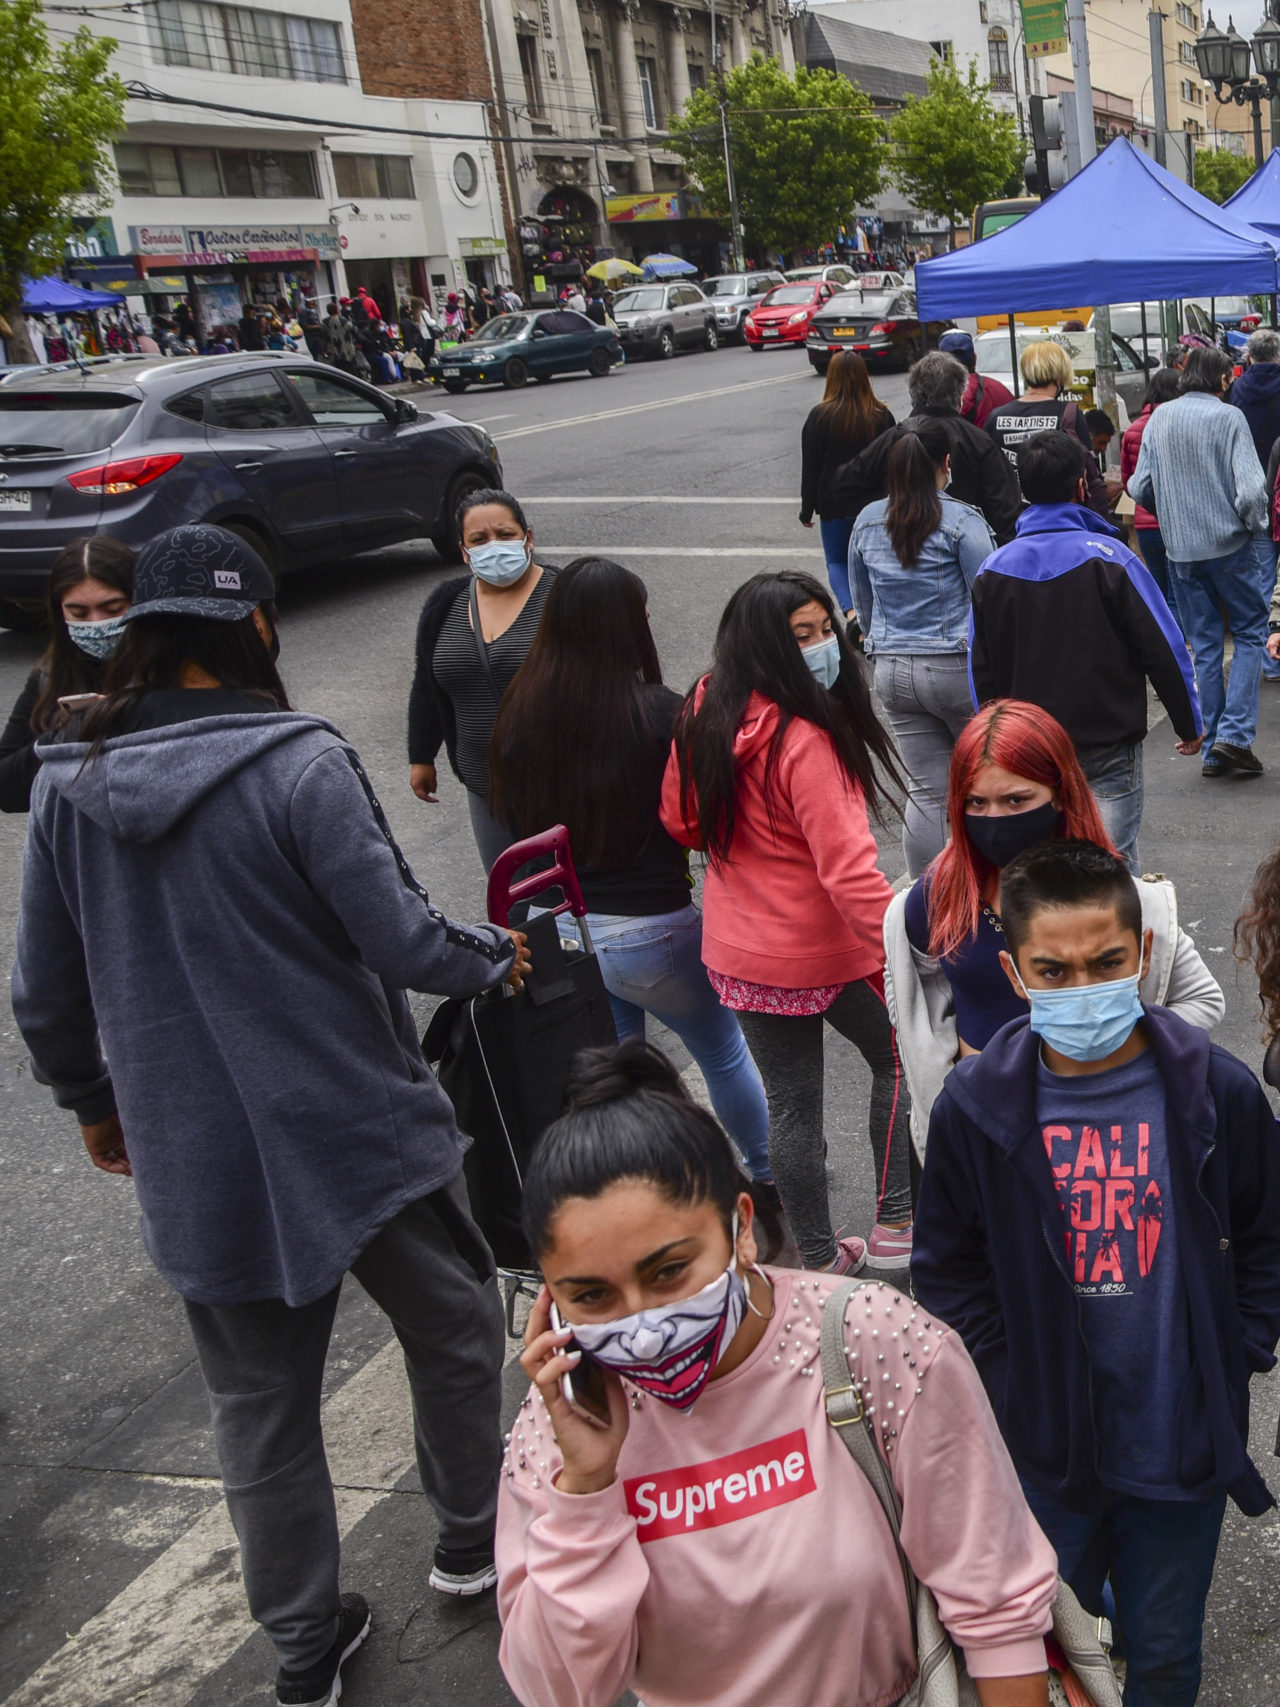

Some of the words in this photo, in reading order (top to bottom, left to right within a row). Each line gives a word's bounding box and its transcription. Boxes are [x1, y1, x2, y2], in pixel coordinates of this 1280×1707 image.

[139, 228, 183, 245] Bordados
[997, 417, 1012, 427] LES
[217, 575, 238, 585] UA
[1041, 1122, 1150, 1178] CALI
[1064, 1231, 1124, 1283] IA
[1099, 1283, 1126, 1293] 1850
[635, 1451, 805, 1527] Supreme
